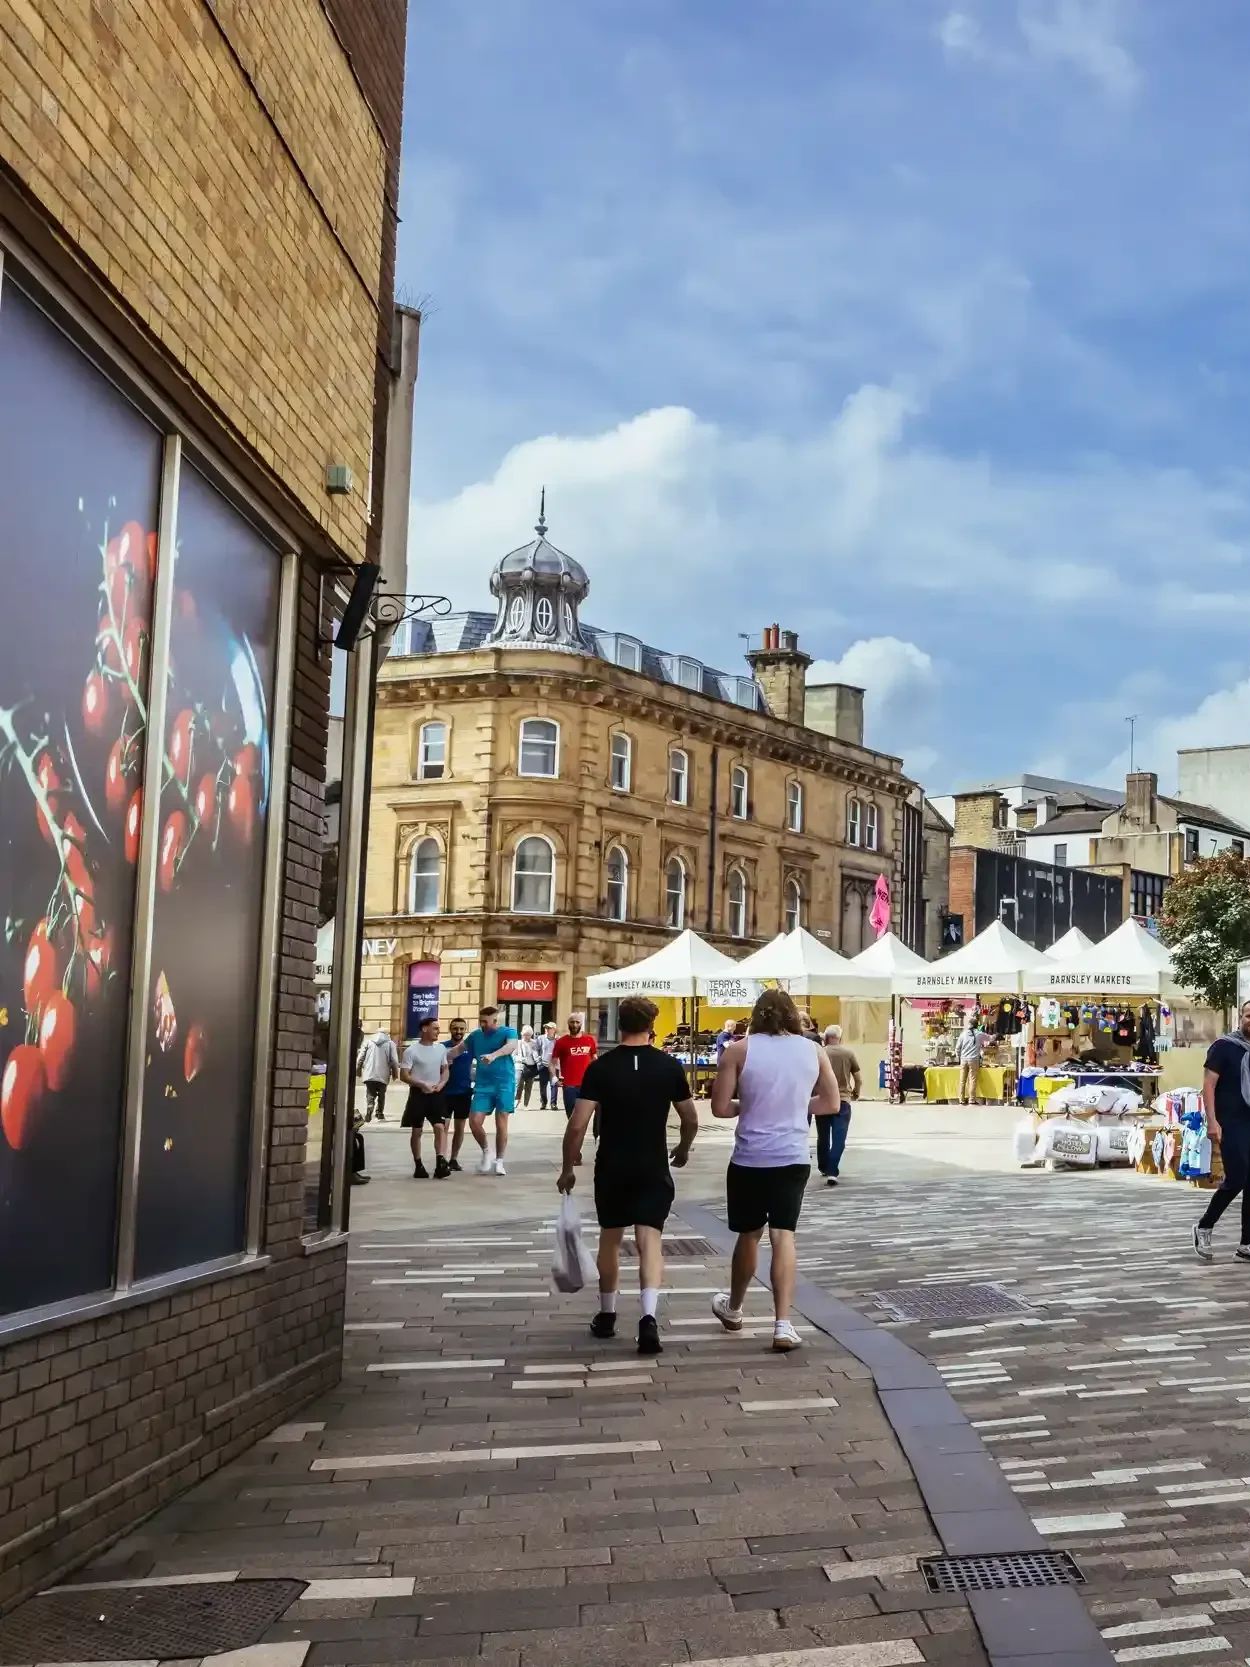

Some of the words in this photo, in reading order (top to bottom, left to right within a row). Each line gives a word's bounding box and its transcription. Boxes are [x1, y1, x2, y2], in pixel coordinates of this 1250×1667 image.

[501, 979, 550, 991] MONEY
[917, 976, 955, 986] BARNSLEY
[957, 975, 993, 985] MARKETS
[1050, 974, 1091, 985] BARNSLEY
[1093, 975, 1131, 985] MARKETS
[608, 981, 639, 990] BARNSLEY
[641, 981, 671, 989] MARKETS
[709, 988, 747, 998] TRAINERS
